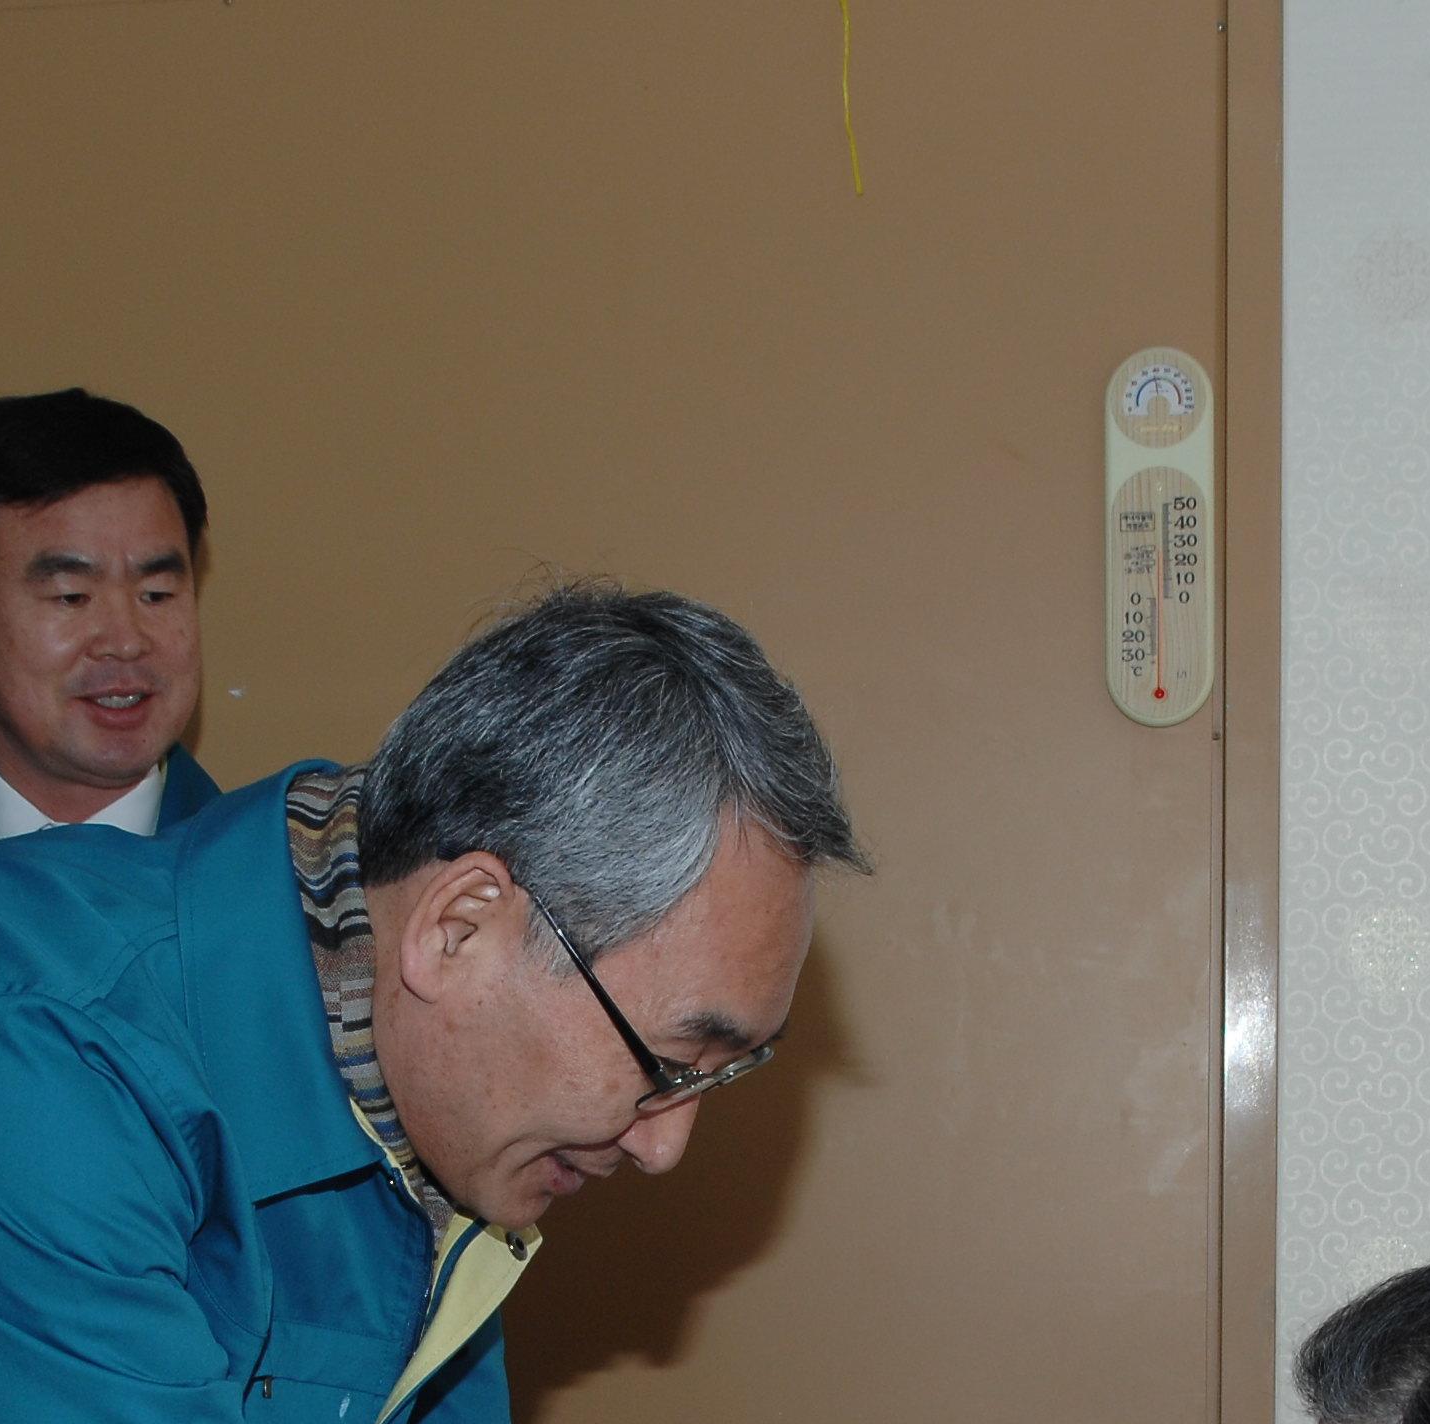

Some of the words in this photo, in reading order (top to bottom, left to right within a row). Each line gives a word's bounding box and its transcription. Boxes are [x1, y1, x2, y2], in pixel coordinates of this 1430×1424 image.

[1173, 497, 1197, 511] 50
[1174, 515, 1197, 529] 40
[1173, 533, 1198, 548] 30
[1174, 553, 1198, 567] 20
[1176, 571, 1195, 585] 10
[1130, 592, 1141, 605] 0
[1179, 591, 1190, 604] 0
[1124, 611, 1143, 625] 10
[1122, 630, 1145, 643] 20
[1121, 648, 1145, 662] 30
